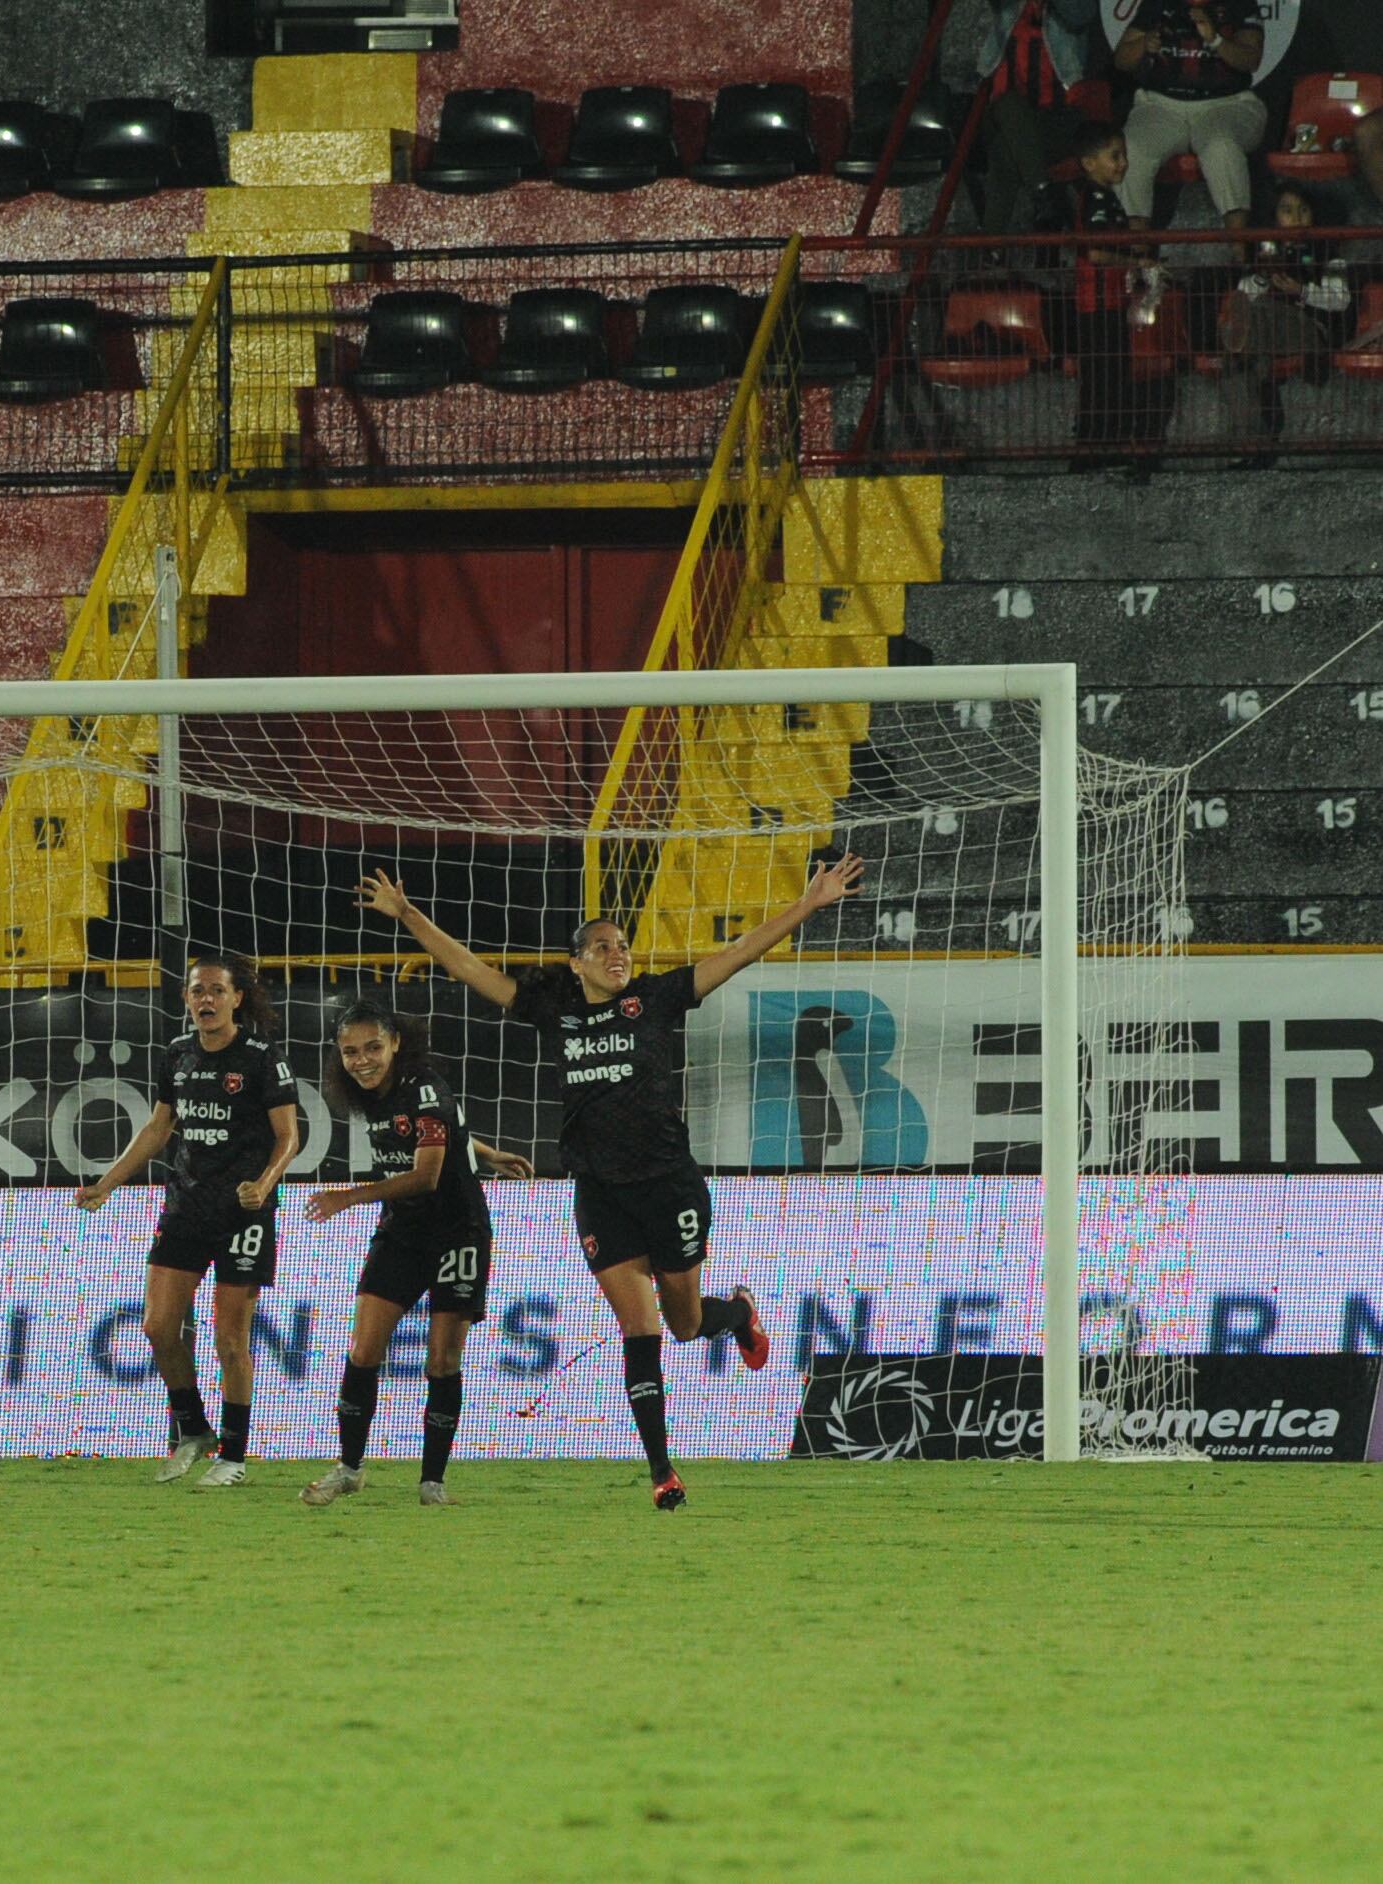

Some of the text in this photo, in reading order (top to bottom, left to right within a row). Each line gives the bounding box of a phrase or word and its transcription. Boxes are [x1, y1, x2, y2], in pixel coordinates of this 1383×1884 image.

[1118, 586, 1159, 617] 17
[1254, 582, 1297, 614] 16
[1080, 694, 1122, 726] 17
[1219, 690, 1262, 721] 16
[1350, 690, 1383, 721] 15
[1186, 798, 1230, 830] 16
[1316, 798, 1358, 830] 15
[1000, 910, 1042, 942] 17
[1284, 906, 1324, 938] 15
[585, 1033, 635, 1056] kölbi
[566, 1063, 634, 1085] monge
[188, 1099, 232, 1121] kölbi
[183, 1127, 229, 1146] onge
[677, 1208, 699, 1241] 9
[228, 1225, 264, 1256] 18
[437, 1246, 478, 1284] 20
[956, 1400, 1045, 1448] Liga
[1257, 1444, 1335, 1457] Femenino
